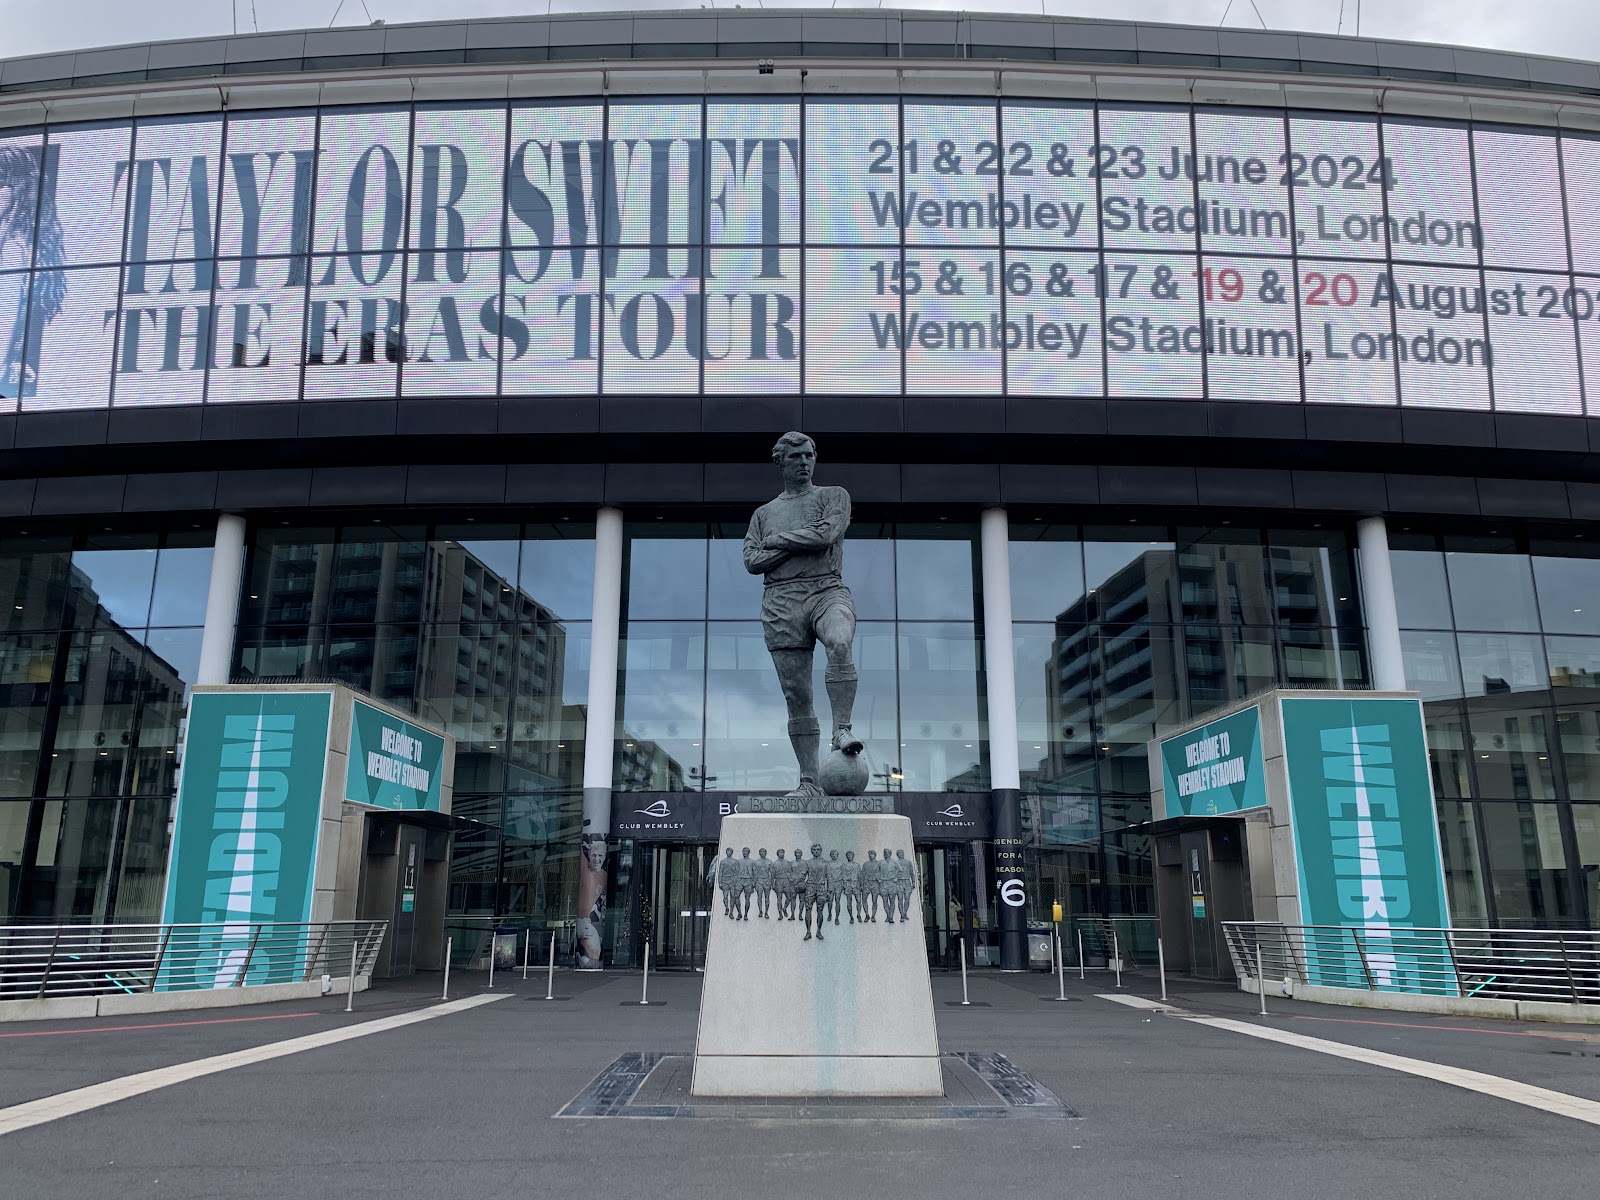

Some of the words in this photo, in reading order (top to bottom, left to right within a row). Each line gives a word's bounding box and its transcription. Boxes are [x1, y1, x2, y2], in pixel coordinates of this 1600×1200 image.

[868, 140, 917, 176] 21
[933, 140, 963, 176] &
[975, 140, 1034, 178] 22
[1046, 142, 1077, 178] &
[1088, 144, 1146, 181] 23
[1158, 145, 1267, 186] June
[1280, 151, 1398, 192] 2024
[112, 143, 473, 295] TAYLOR
[505, 138, 800, 284] SWIFT
[868, 192, 1084, 238] Wembley
[1103, 196, 1305, 245] Stadium,
[1317, 206, 1481, 252] London
[868, 261, 922, 297] 15
[934, 261, 964, 297] &
[978, 261, 1033, 298] 16
[1045, 262, 1075, 299] &
[1088, 264, 1139, 300] 17
[1151, 265, 1180, 301] &
[1192, 267, 1244, 303] 19
[1257, 269, 1287, 305] &
[1303, 272, 1358, 307] 20
[1370, 273, 1528, 319] August
[103, 301, 271, 373] THE
[298, 293, 531, 365] ERAS
[556, 291, 800, 361] TOUR
[868, 312, 1087, 359] Wembley
[1105, 315, 1312, 367] Stadium,
[1324, 322, 1494, 368] London
[381, 726, 414, 760] WELCOME
[414, 739, 423, 763] TO
[1185, 735, 1220, 768] WELCOME
[1219, 731, 1230, 757] TO
[367, 750, 402, 784] WEMBLEY
[401, 763, 429, 793] STADIUM
[1177, 766, 1210, 797] WEMBLEY
[1210, 756, 1245, 789] STADIUM
[751, 797, 812, 813] BOBBY
[816, 797, 883, 813] MOORE
